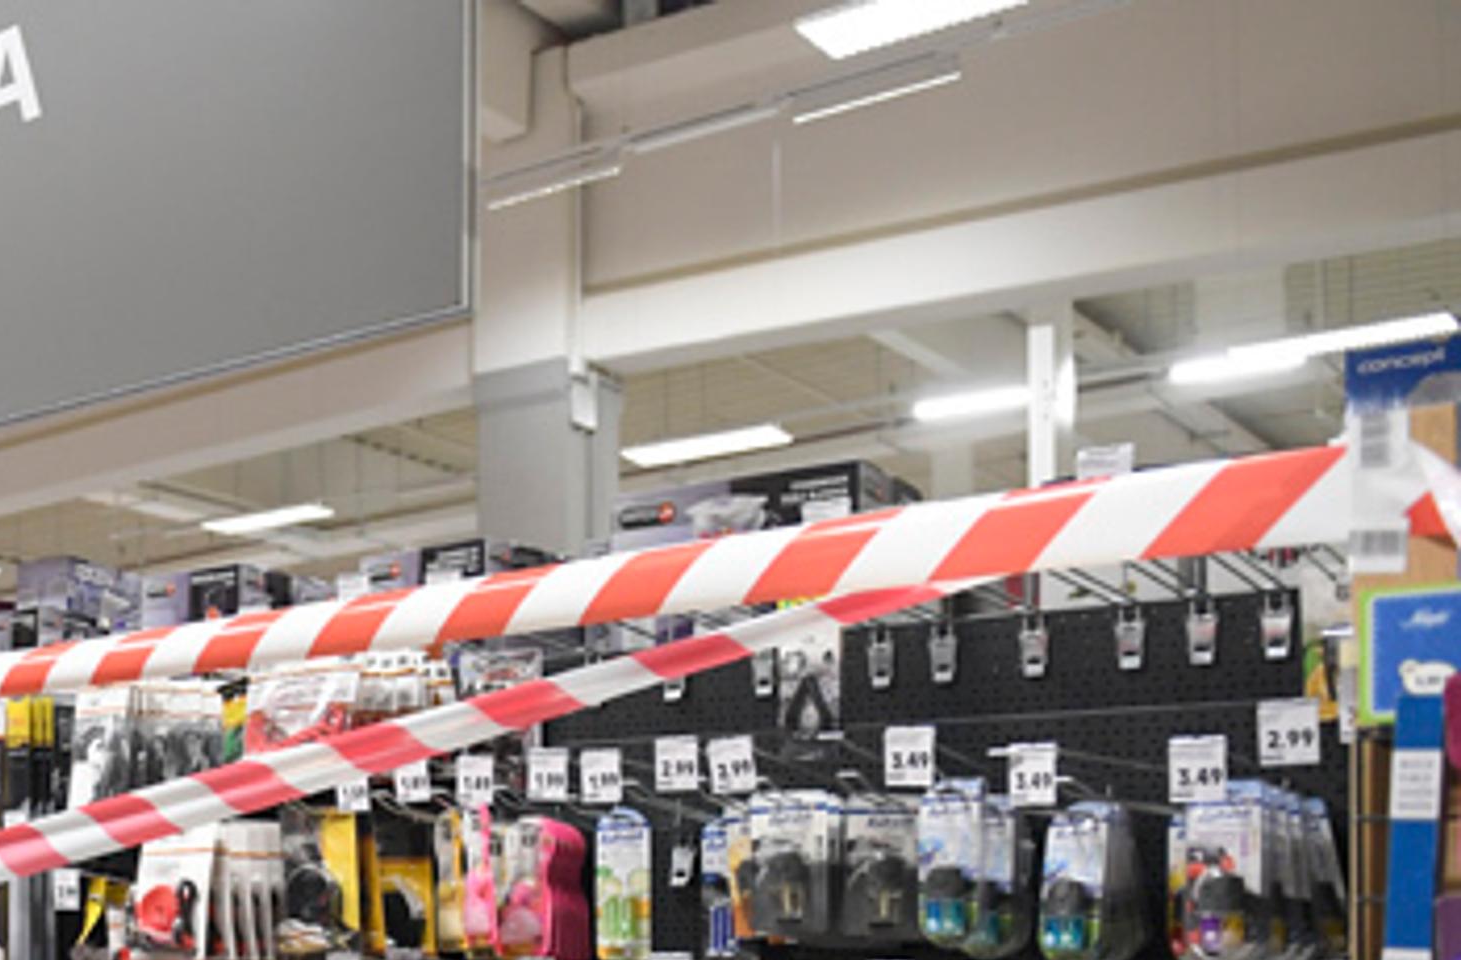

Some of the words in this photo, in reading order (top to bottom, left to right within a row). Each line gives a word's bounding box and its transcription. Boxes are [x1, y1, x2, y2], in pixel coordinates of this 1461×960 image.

[1267, 729, 1314, 751] 2.99
[890, 748, 930, 771] 3.49
[1014, 770, 1053, 791] 3.49
[1177, 764, 1223, 788] 3.49
